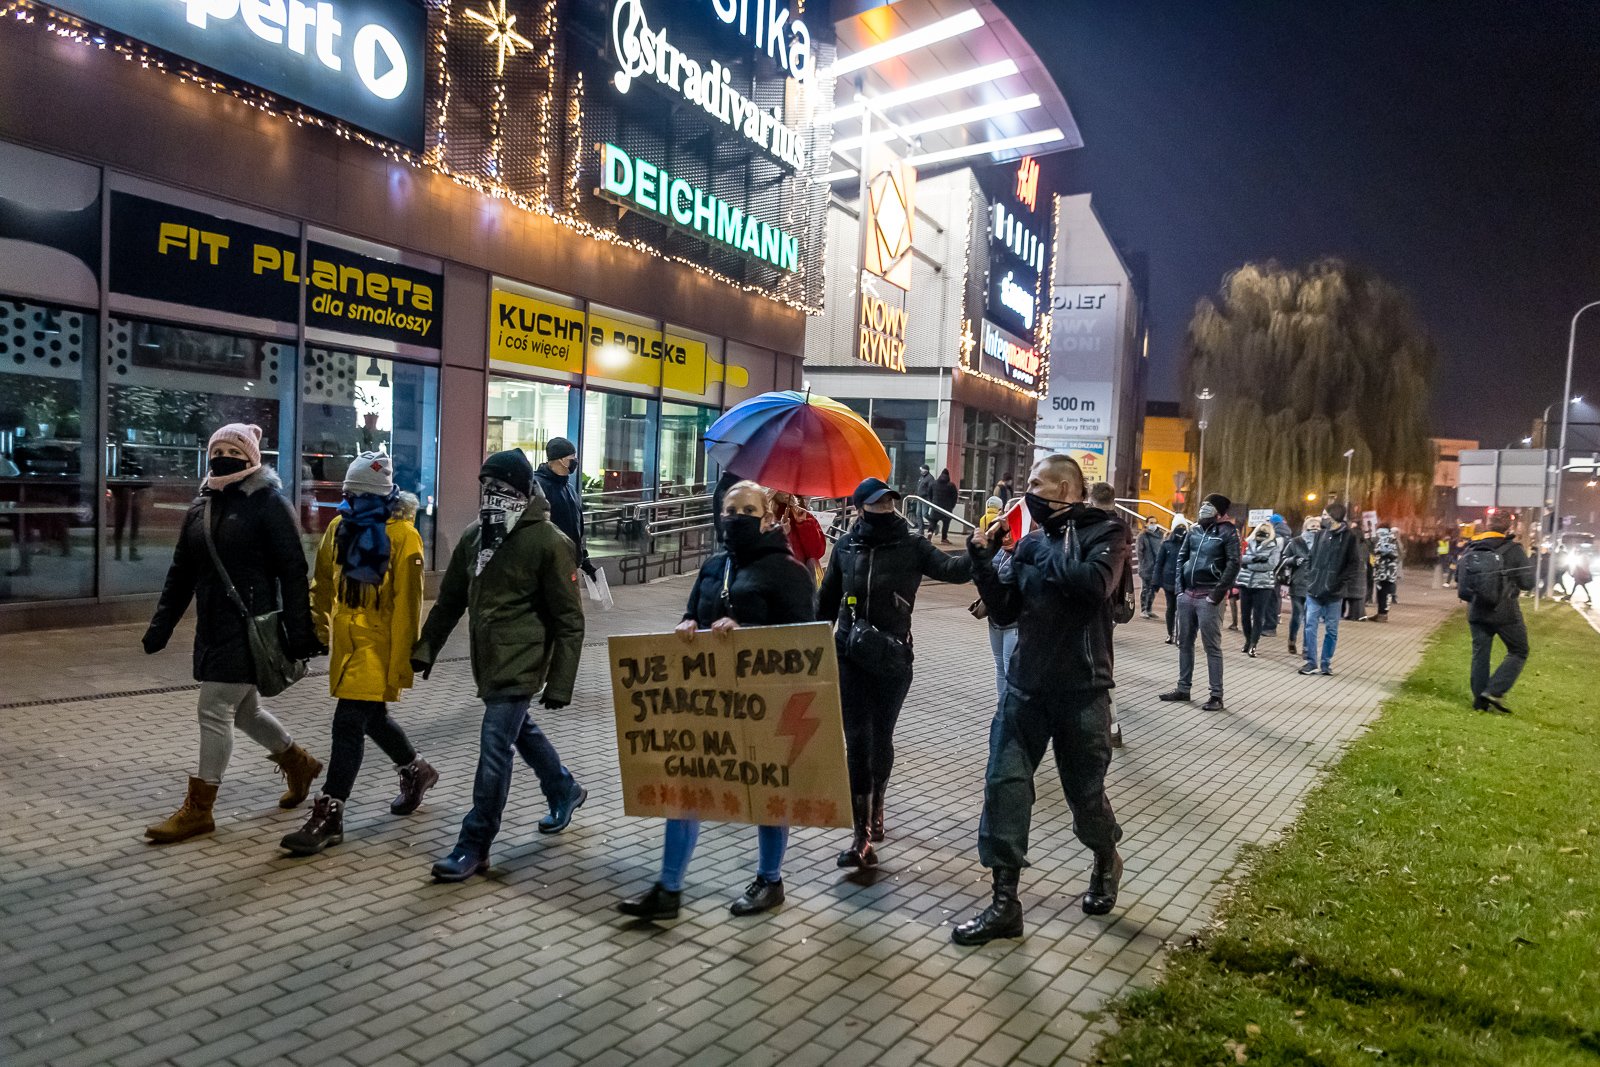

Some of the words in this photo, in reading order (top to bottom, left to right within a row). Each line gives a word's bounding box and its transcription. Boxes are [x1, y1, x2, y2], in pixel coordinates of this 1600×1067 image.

[604, 142, 799, 273] DEICHMANN
[158, 222, 230, 265] FIT
[312, 293, 344, 316] dla
[348, 303, 432, 336] smakoszy
[861, 291, 909, 340] NOWY
[498, 331, 503, 347] i
[505, 333, 528, 351] coś
[531, 340, 570, 362] więcej
[860, 327, 907, 373] RYNEK
[1052, 396, 1078, 411] 500
[1081, 400, 1095, 411] m
[682, 652, 716, 680] MI
[736, 647, 824, 678] FARBY
[625, 729, 696, 755] TYLKO
[703, 730, 737, 756] NA
[664, 755, 790, 788] GWIAZDKI
